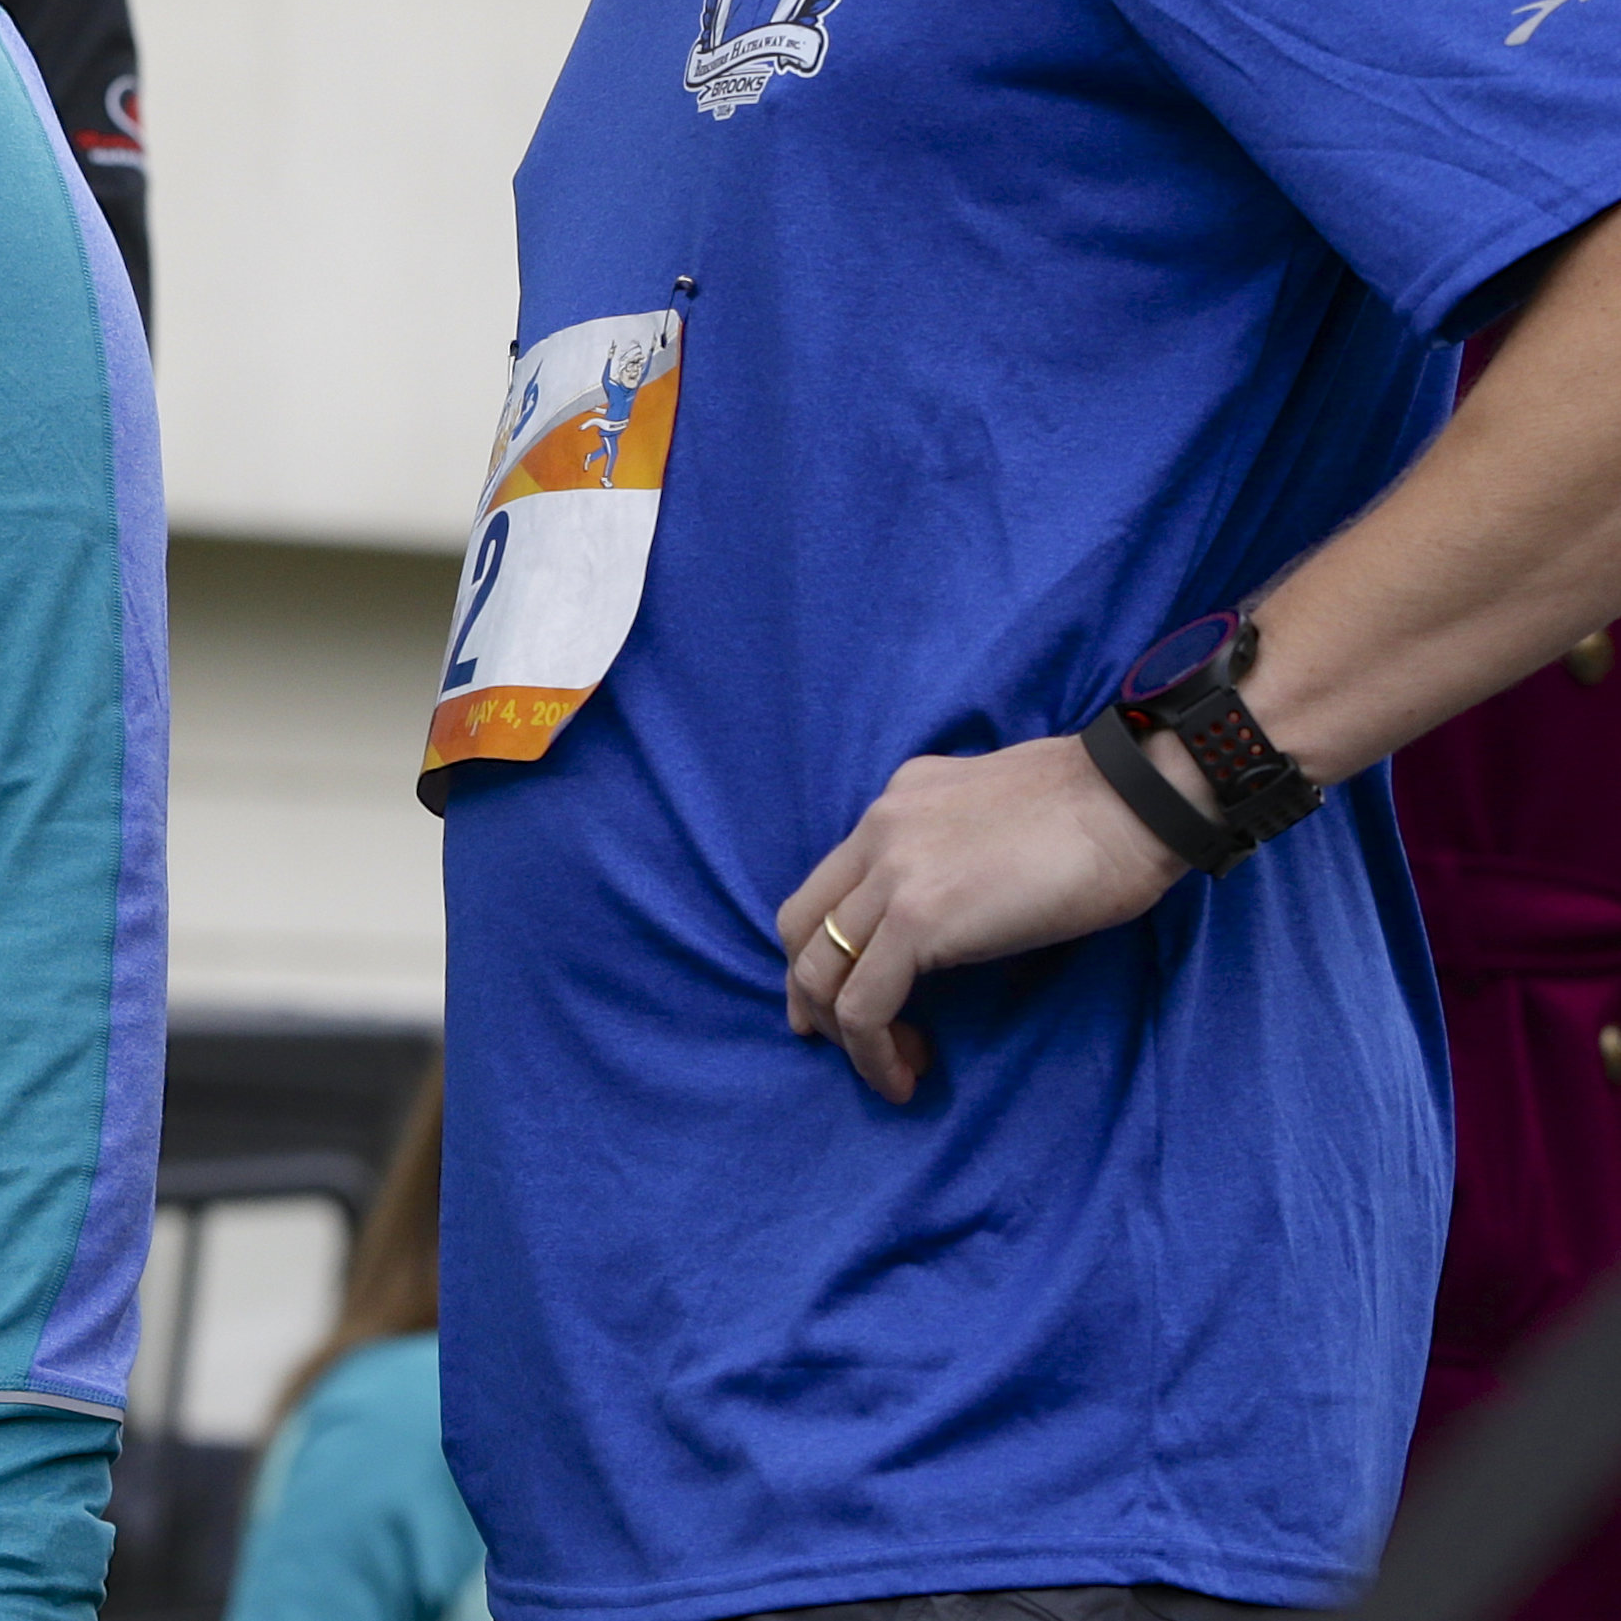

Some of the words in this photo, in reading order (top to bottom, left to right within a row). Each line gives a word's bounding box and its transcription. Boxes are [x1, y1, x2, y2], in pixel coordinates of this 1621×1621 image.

[711, 76, 766, 97] BROOKS
[440, 509, 511, 697] 2
[499, 699, 522, 729] 4,
